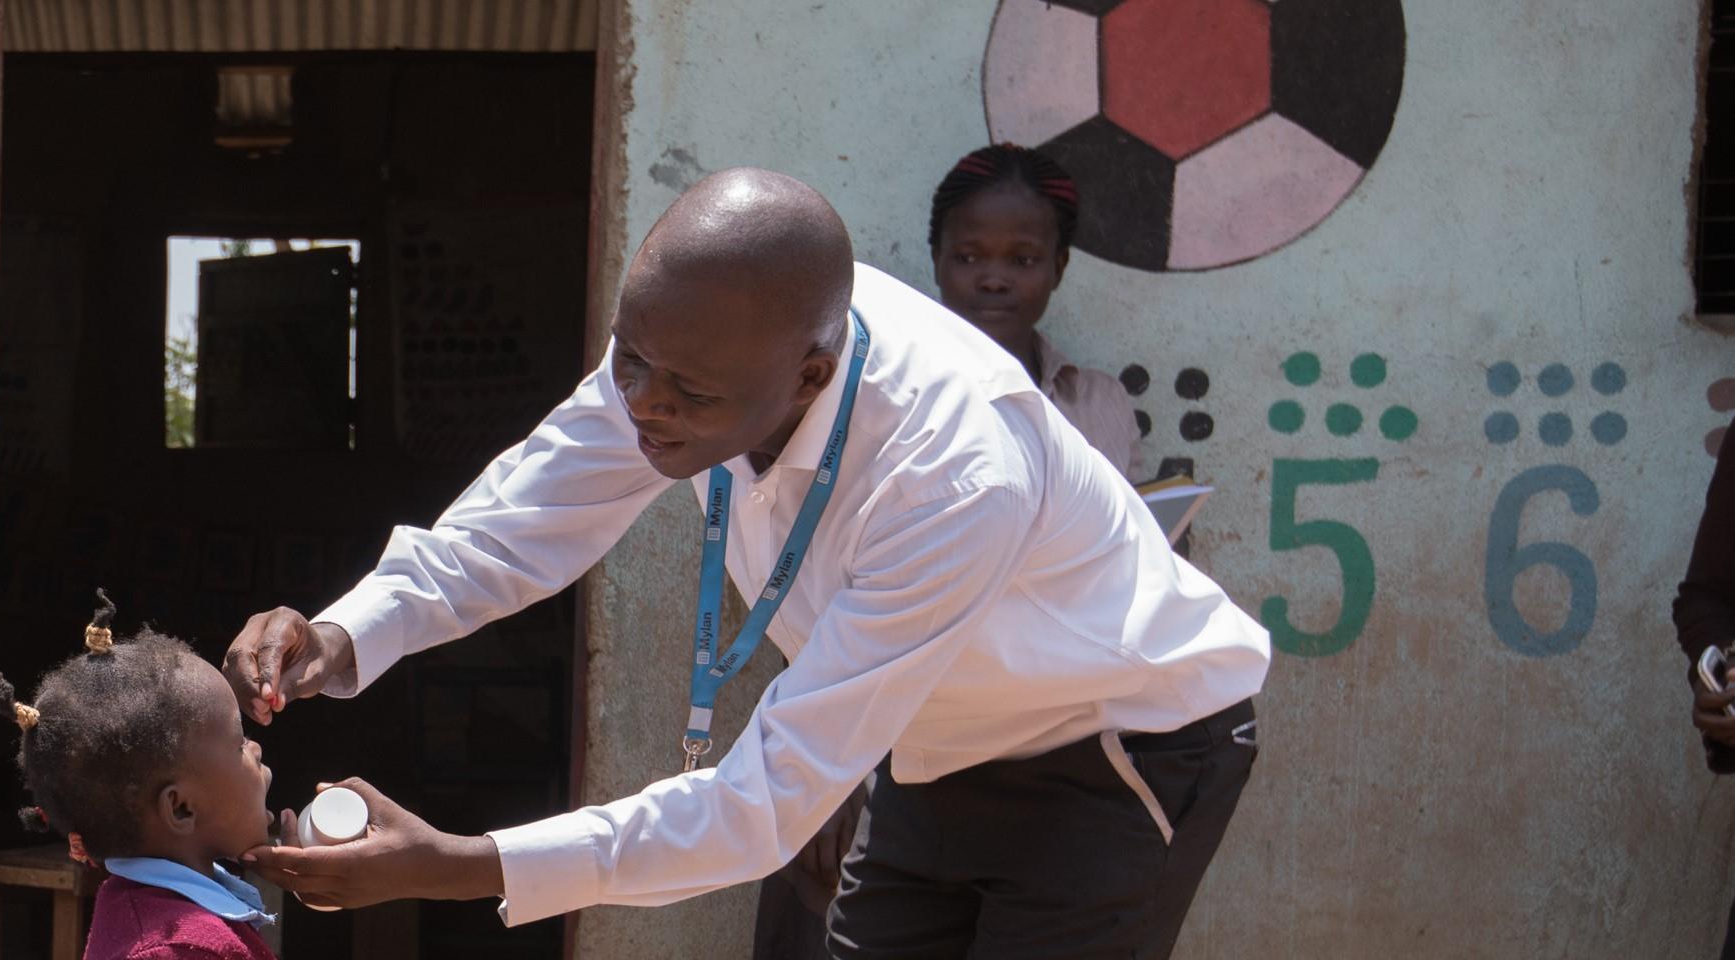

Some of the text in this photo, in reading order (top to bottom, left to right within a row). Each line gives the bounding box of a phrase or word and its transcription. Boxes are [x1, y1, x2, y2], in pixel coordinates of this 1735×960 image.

[823, 429, 843, 469] Mylan
[710, 487, 723, 526] Mylan
[770, 551, 795, 590] Mylan
[1261, 458, 1380, 657] 5
[1485, 464, 1600, 657] 6
[698, 611, 713, 650] Mylan
